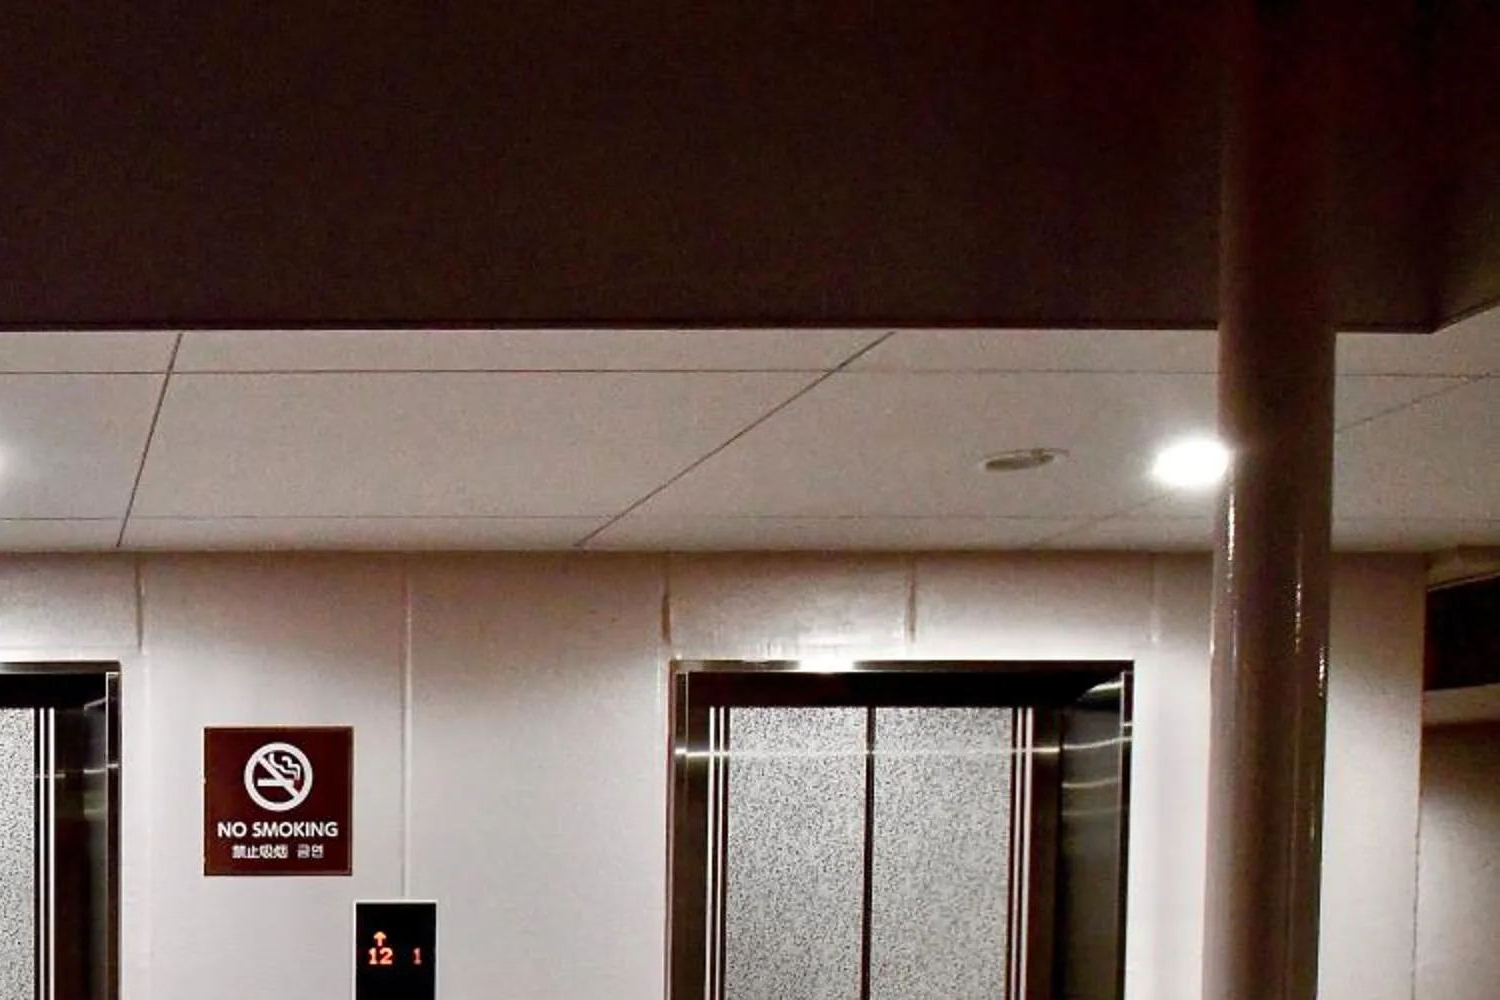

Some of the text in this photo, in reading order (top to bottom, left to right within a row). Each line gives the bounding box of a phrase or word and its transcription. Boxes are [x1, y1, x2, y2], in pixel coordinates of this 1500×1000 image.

[217, 821, 339, 838] NO SMOKING
[368, 947, 393, 965] 12
[413, 947, 422, 965] 1
